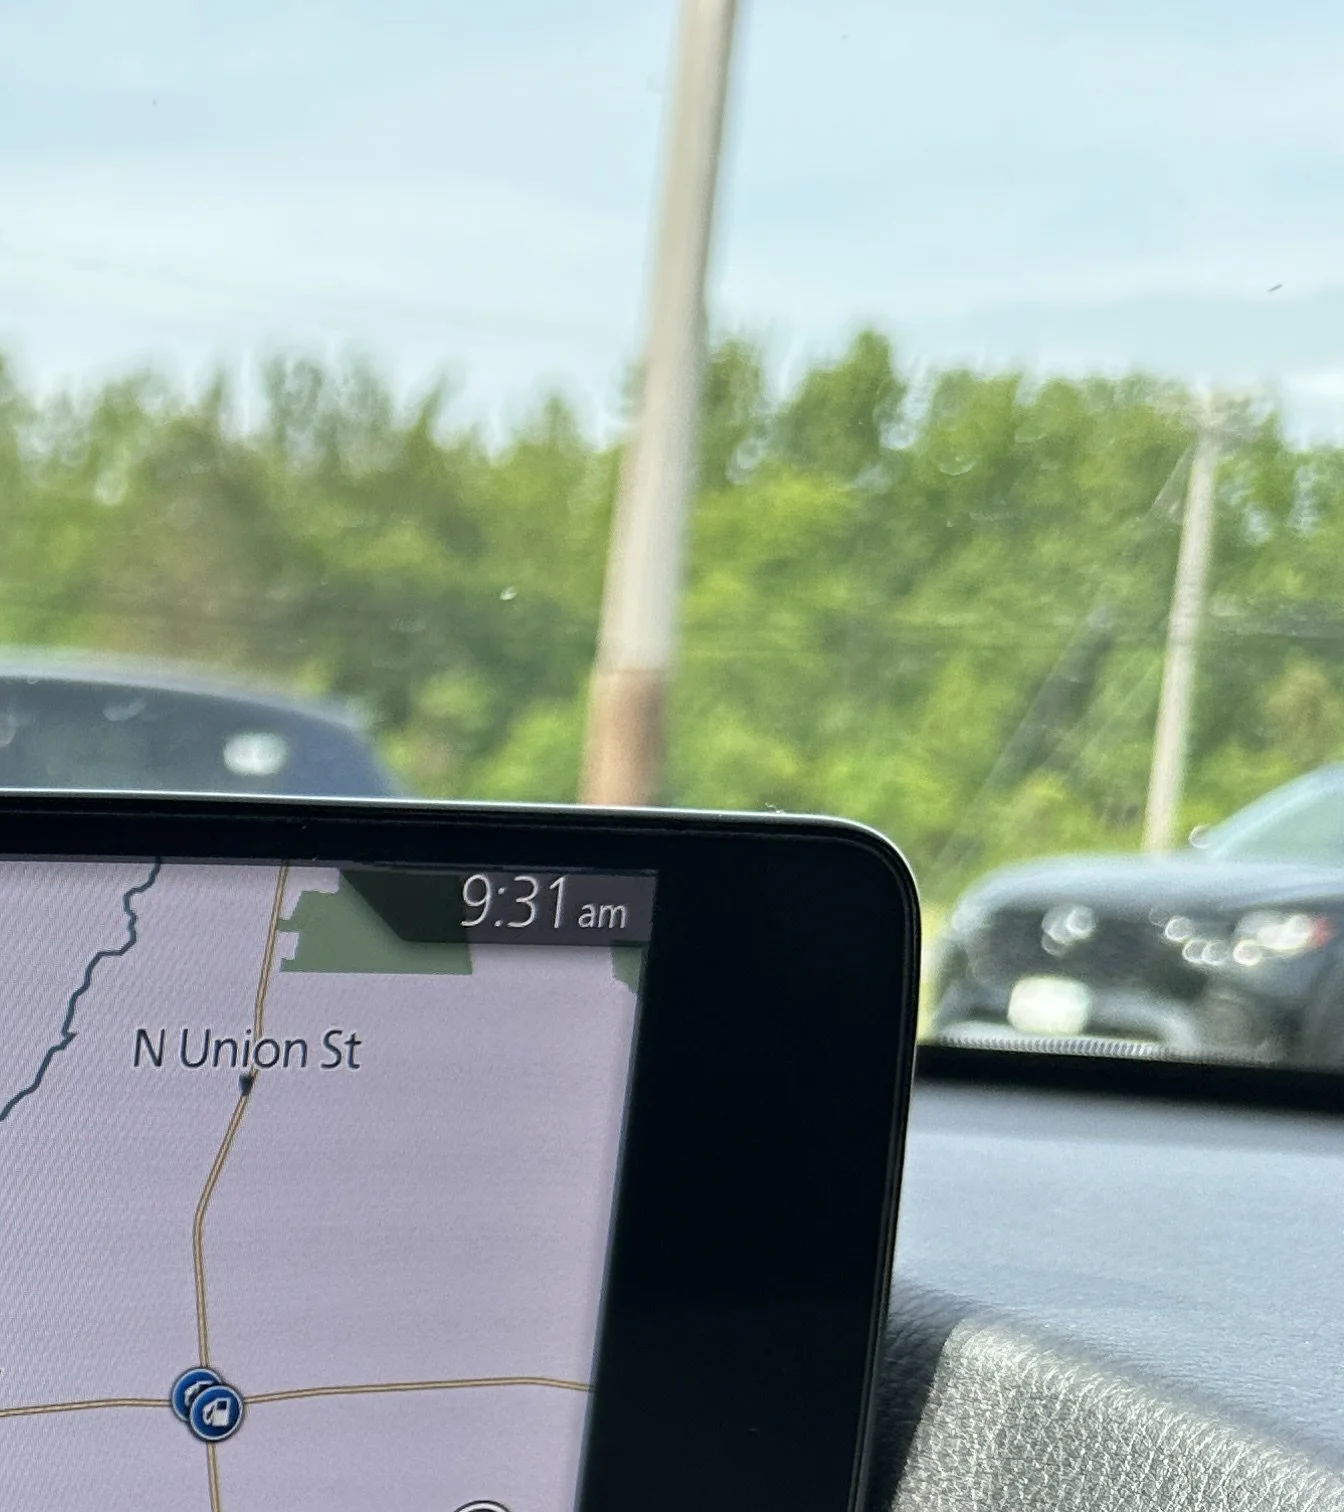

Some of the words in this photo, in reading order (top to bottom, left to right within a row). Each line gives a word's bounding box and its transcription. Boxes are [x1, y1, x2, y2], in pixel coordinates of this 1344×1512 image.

[459, 873, 569, 929] 9:31
[578, 903, 628, 929] am
[133, 1028, 166, 1068] N
[180, 1028, 308, 1069] Union
[320, 1029, 362, 1070] St
